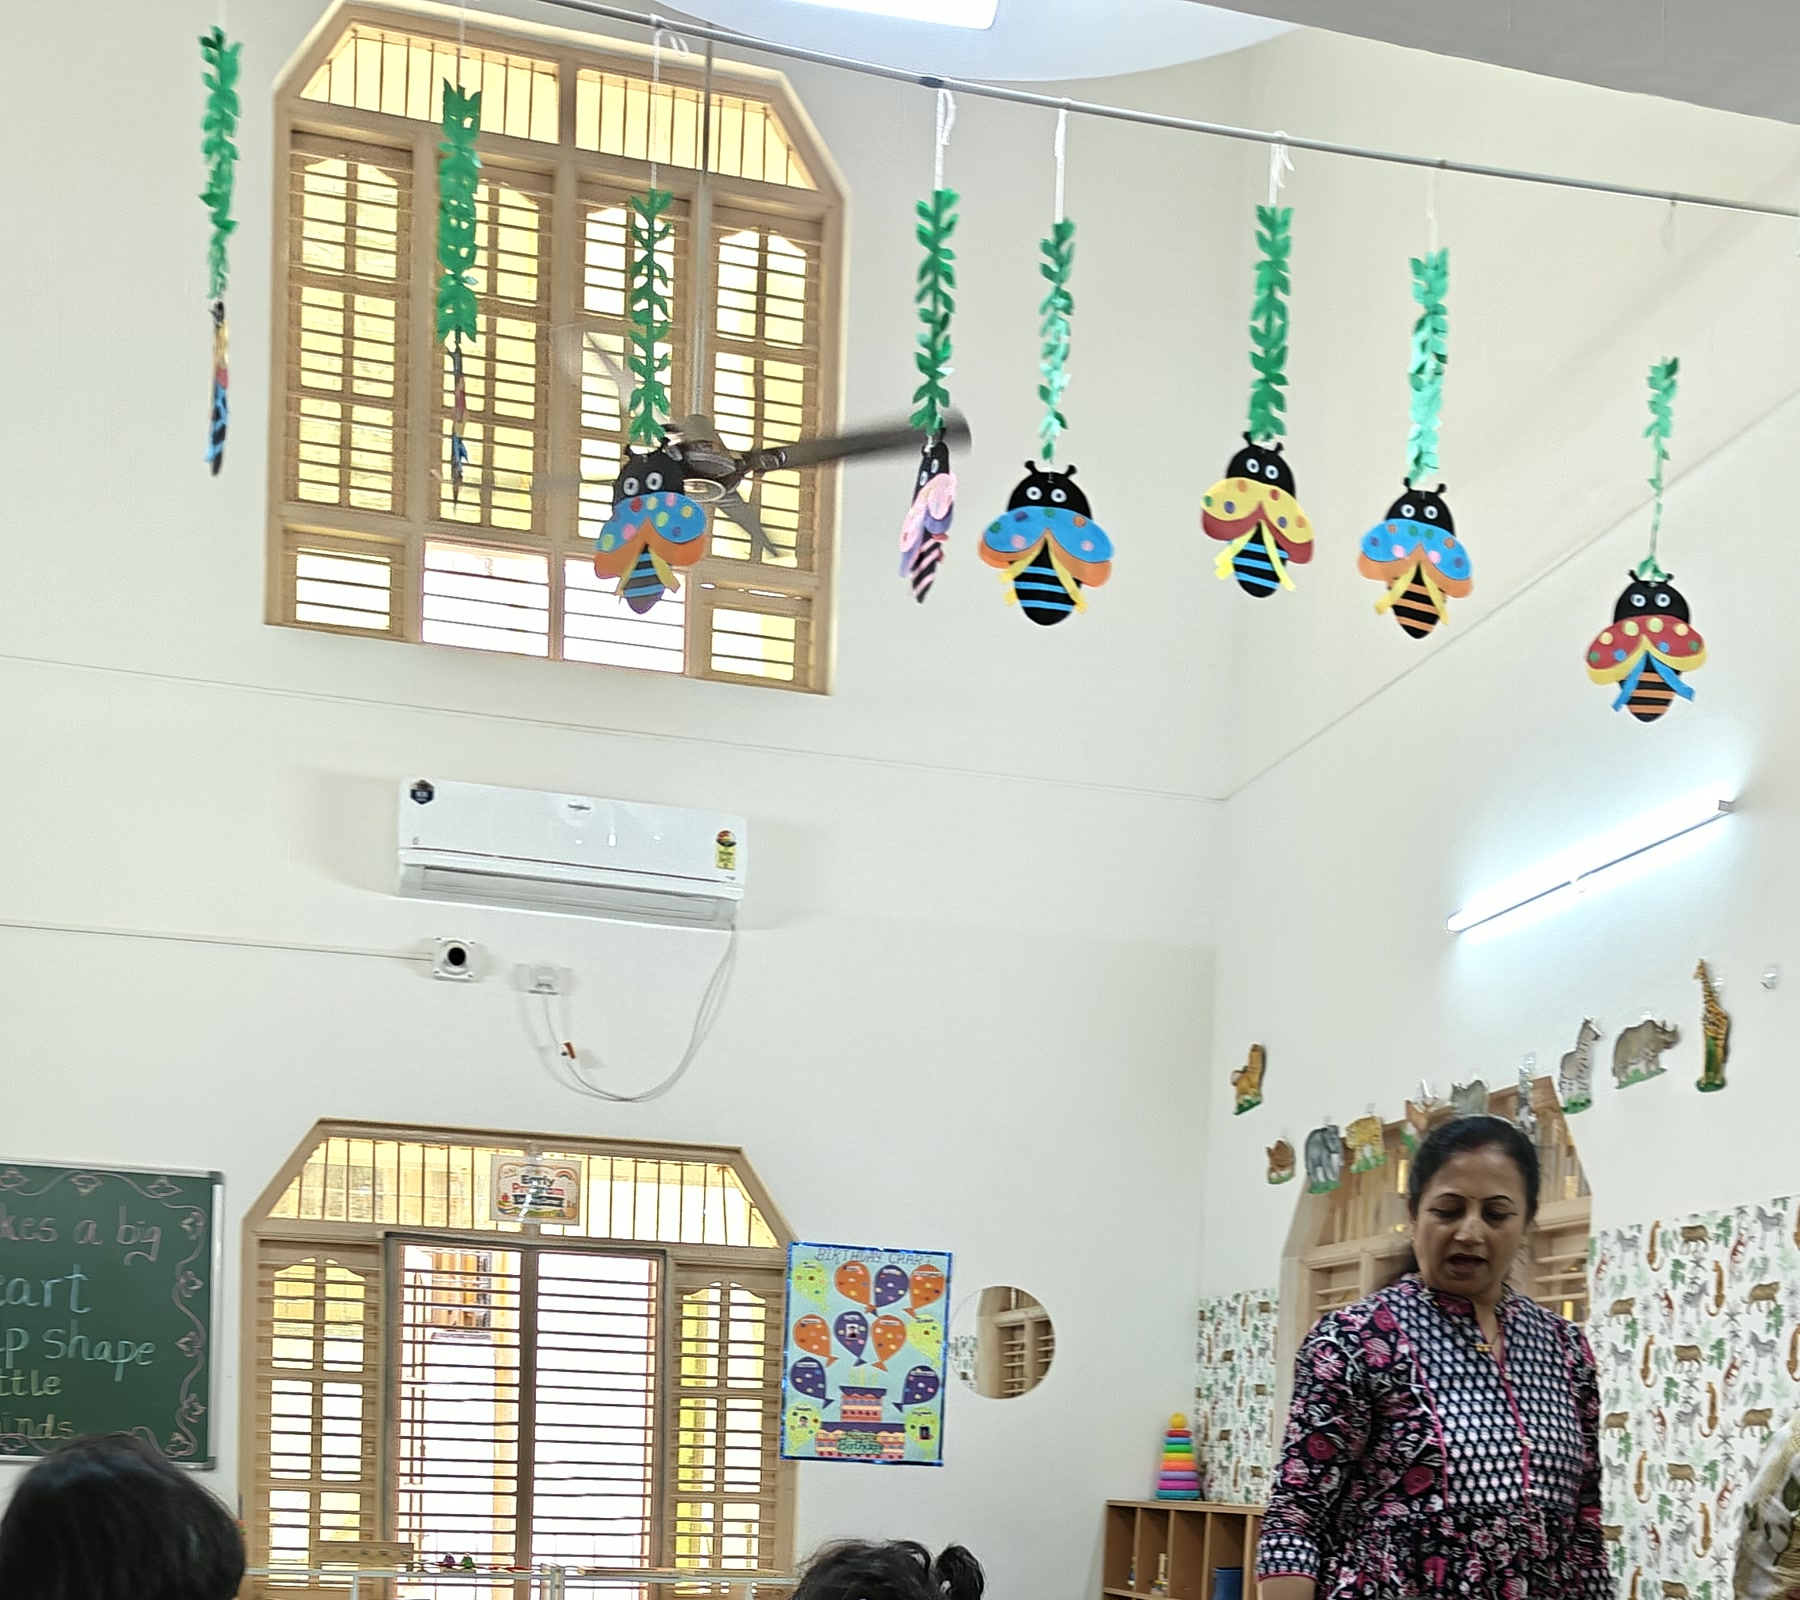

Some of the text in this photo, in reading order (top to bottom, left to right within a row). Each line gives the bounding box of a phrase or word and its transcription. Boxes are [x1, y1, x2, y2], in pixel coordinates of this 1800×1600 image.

[73, 1220, 103, 1245] a
[116, 1205, 162, 1266] big
[0, 1327, 30, 1369] p
